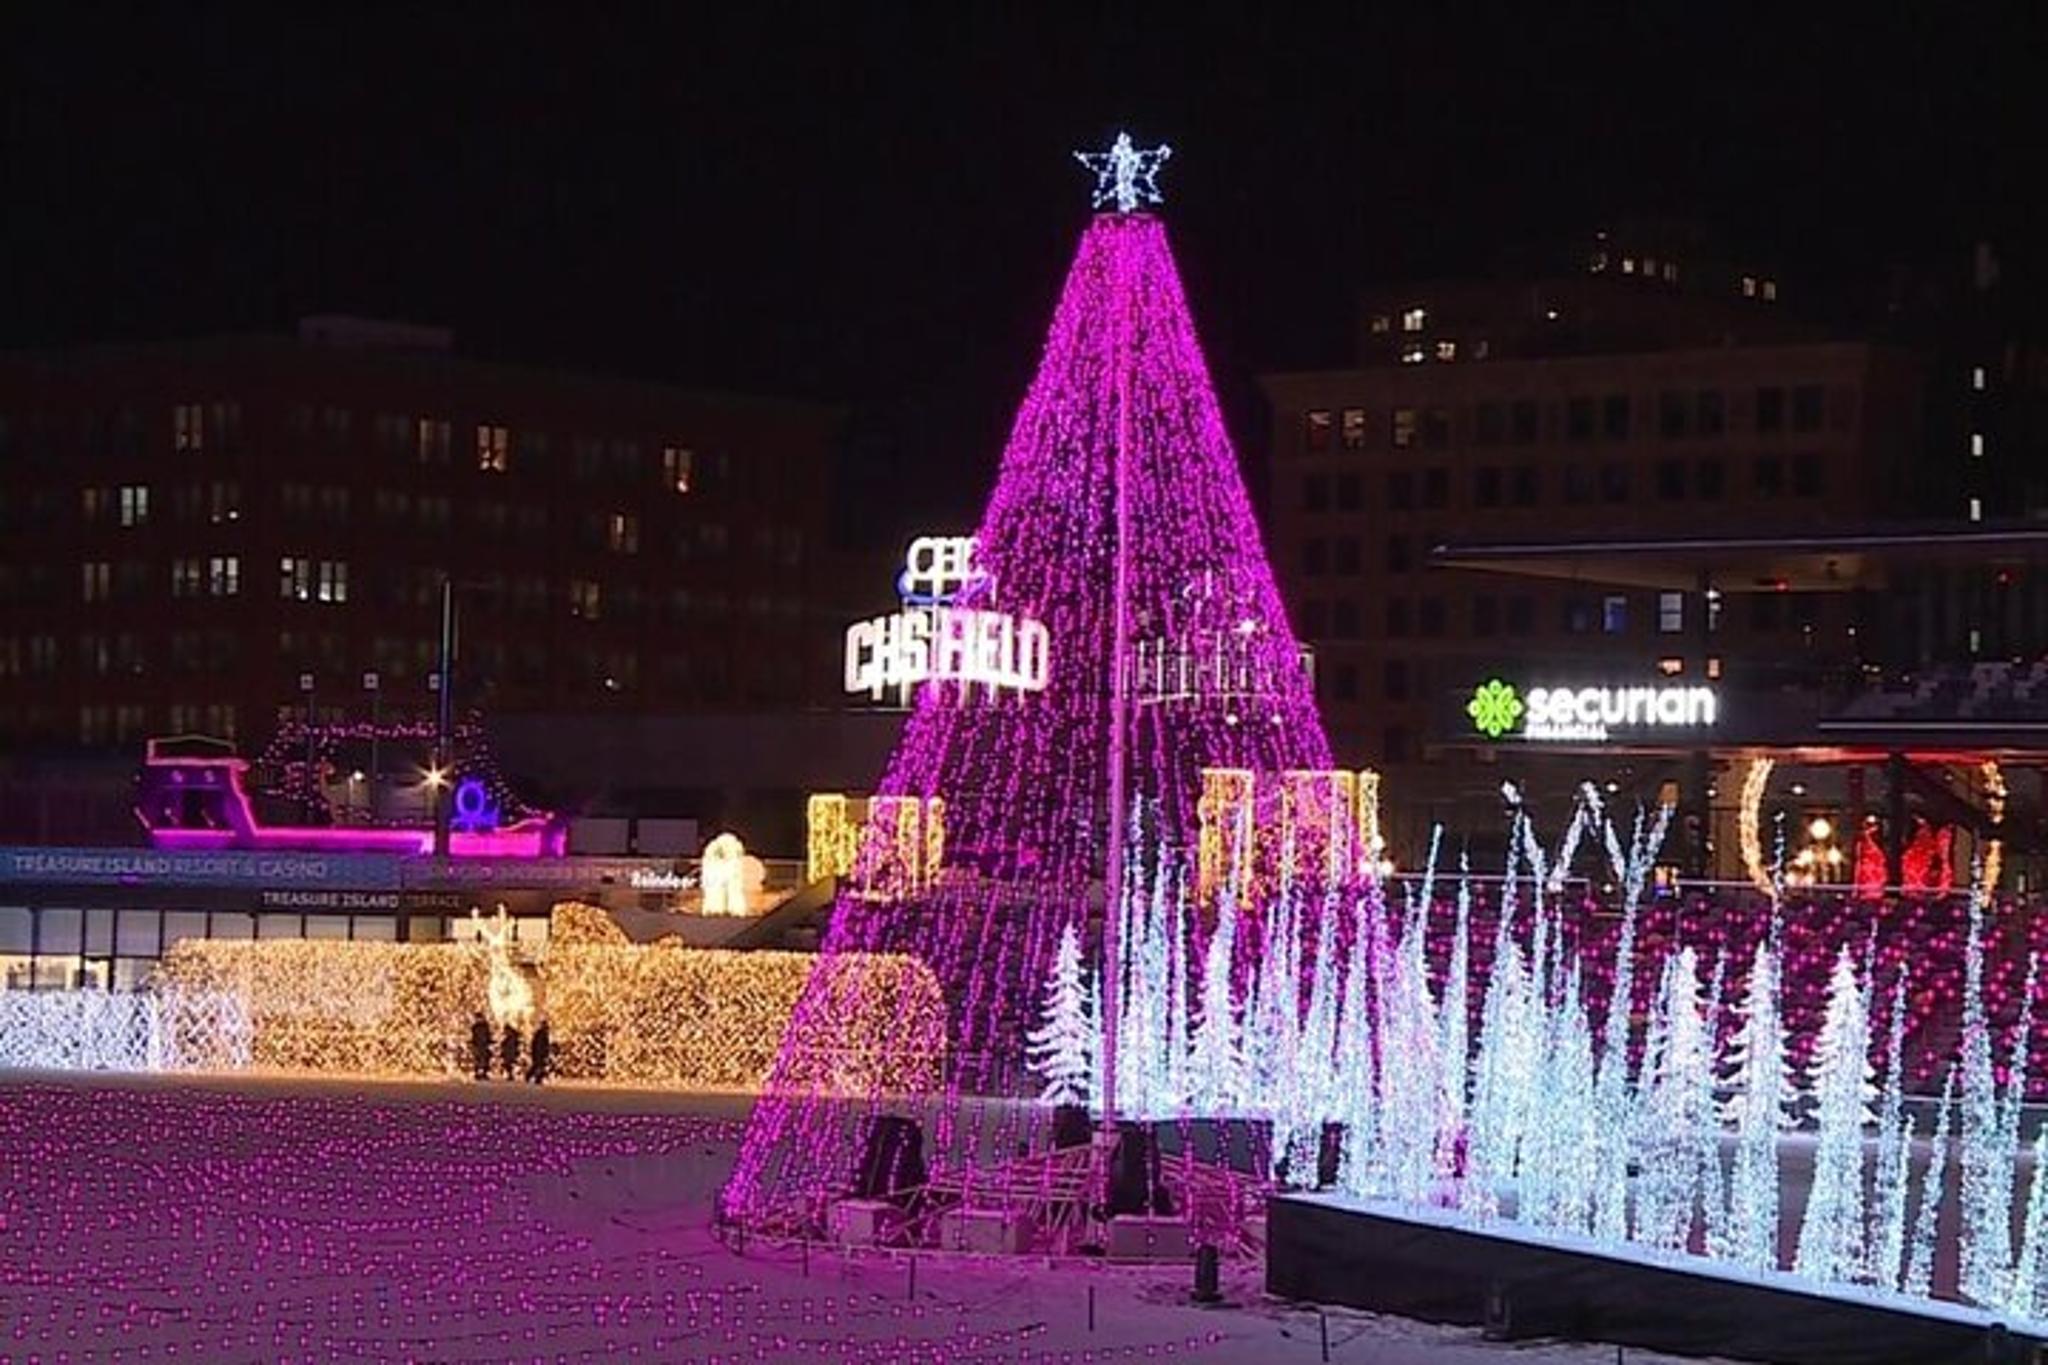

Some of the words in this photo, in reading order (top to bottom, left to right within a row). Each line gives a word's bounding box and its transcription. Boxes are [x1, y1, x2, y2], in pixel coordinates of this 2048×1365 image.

[845, 611, 929, 692] CHS
[937, 608, 1049, 692] FIELD
[1526, 687, 1716, 724] securian
[14, 855, 101, 873] TREASURE
[104, 856, 170, 875] ISLAND
[258, 860, 328, 878] CASINO
[262, 891, 338, 907] TREASURE
[343, 894, 398, 909] ISLAND
